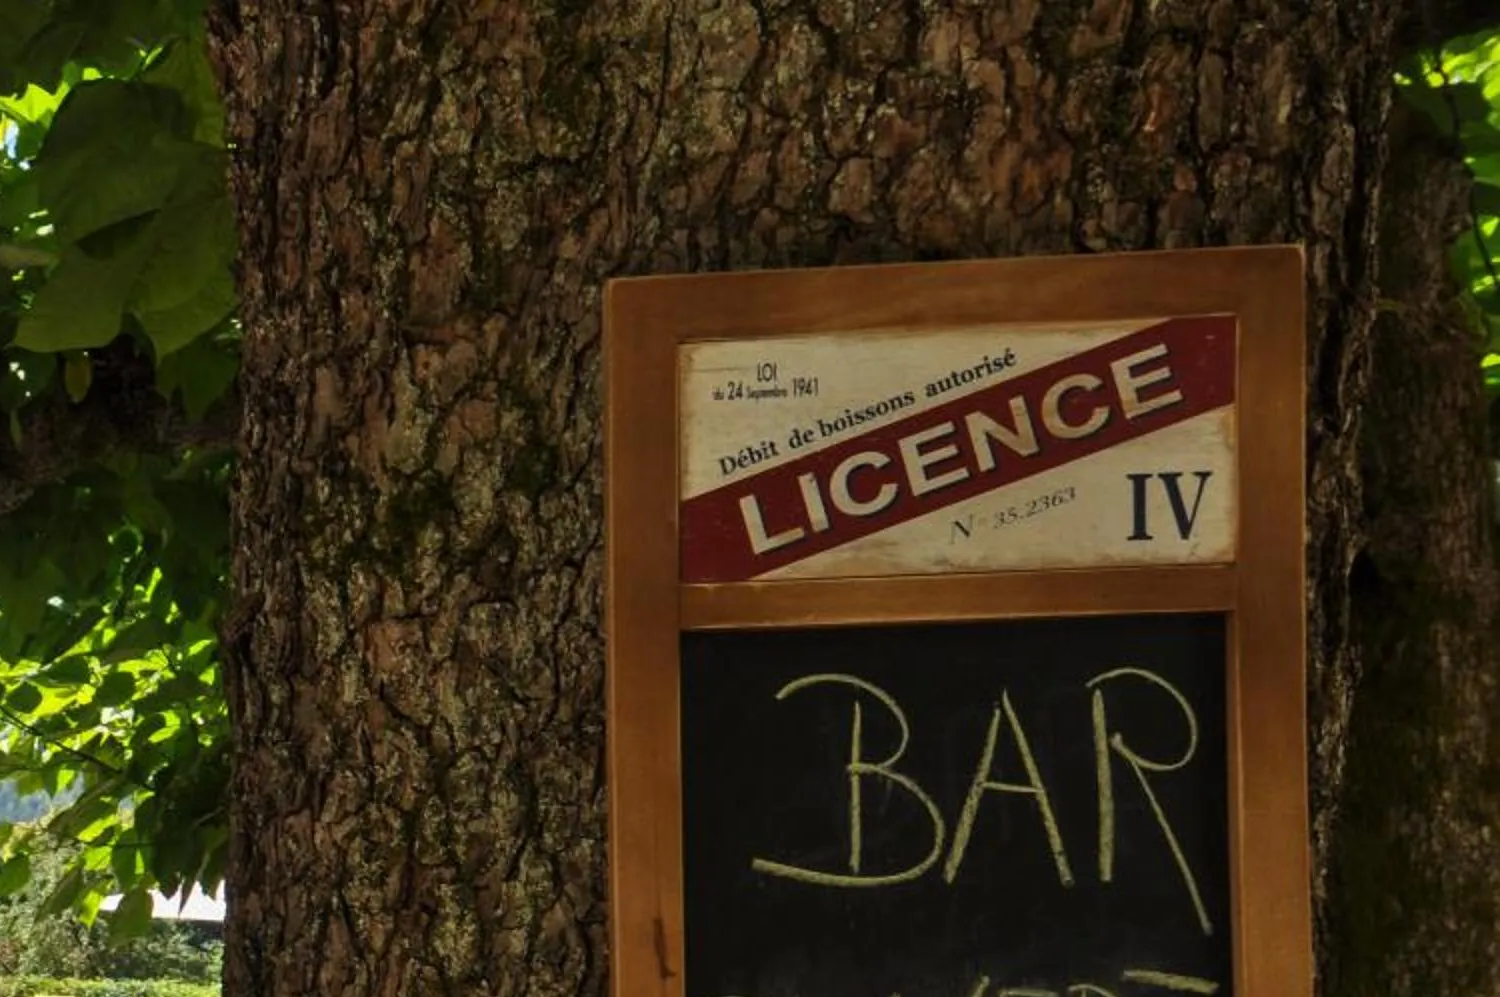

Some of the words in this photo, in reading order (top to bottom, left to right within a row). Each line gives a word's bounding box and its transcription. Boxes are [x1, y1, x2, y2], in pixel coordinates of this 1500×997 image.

[718, 440, 781, 477] Débit
[788, 425, 815, 450] de
[817, 391, 916, 438] boissons
[925, 347, 1018, 398] autorisé
[727, 381, 743, 400] 24
[793, 376, 819, 398] 1941
[757, 361, 777, 382] LOI
[739, 343, 1184, 556] LICENCE
[1125, 471, 1213, 542] IV
[752, 667, 1213, 936] BAR
